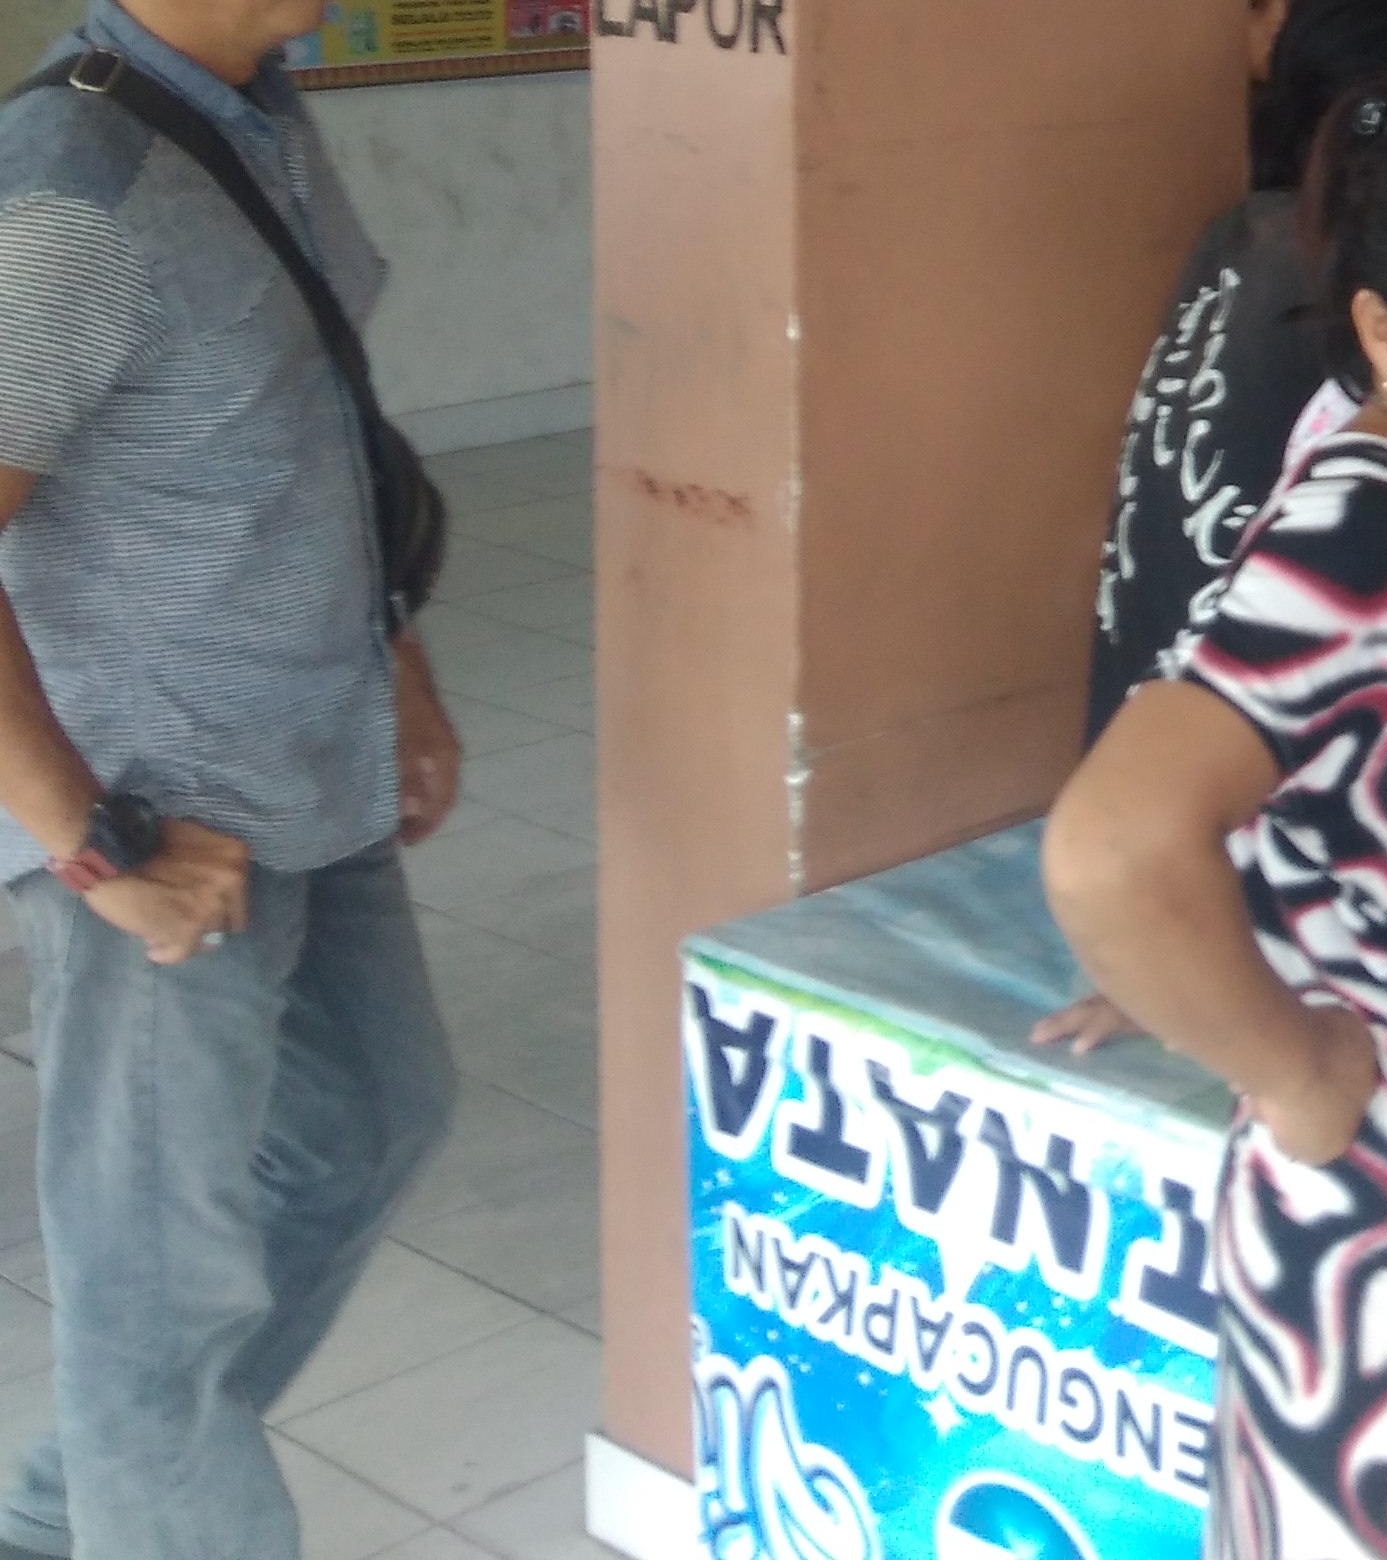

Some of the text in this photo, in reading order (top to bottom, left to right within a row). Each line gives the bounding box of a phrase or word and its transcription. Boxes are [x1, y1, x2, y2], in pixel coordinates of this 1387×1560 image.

[686, 981, 1217, 1334] T NATA
[730, 1214, 1215, 1490] ENGUCAPKAN
